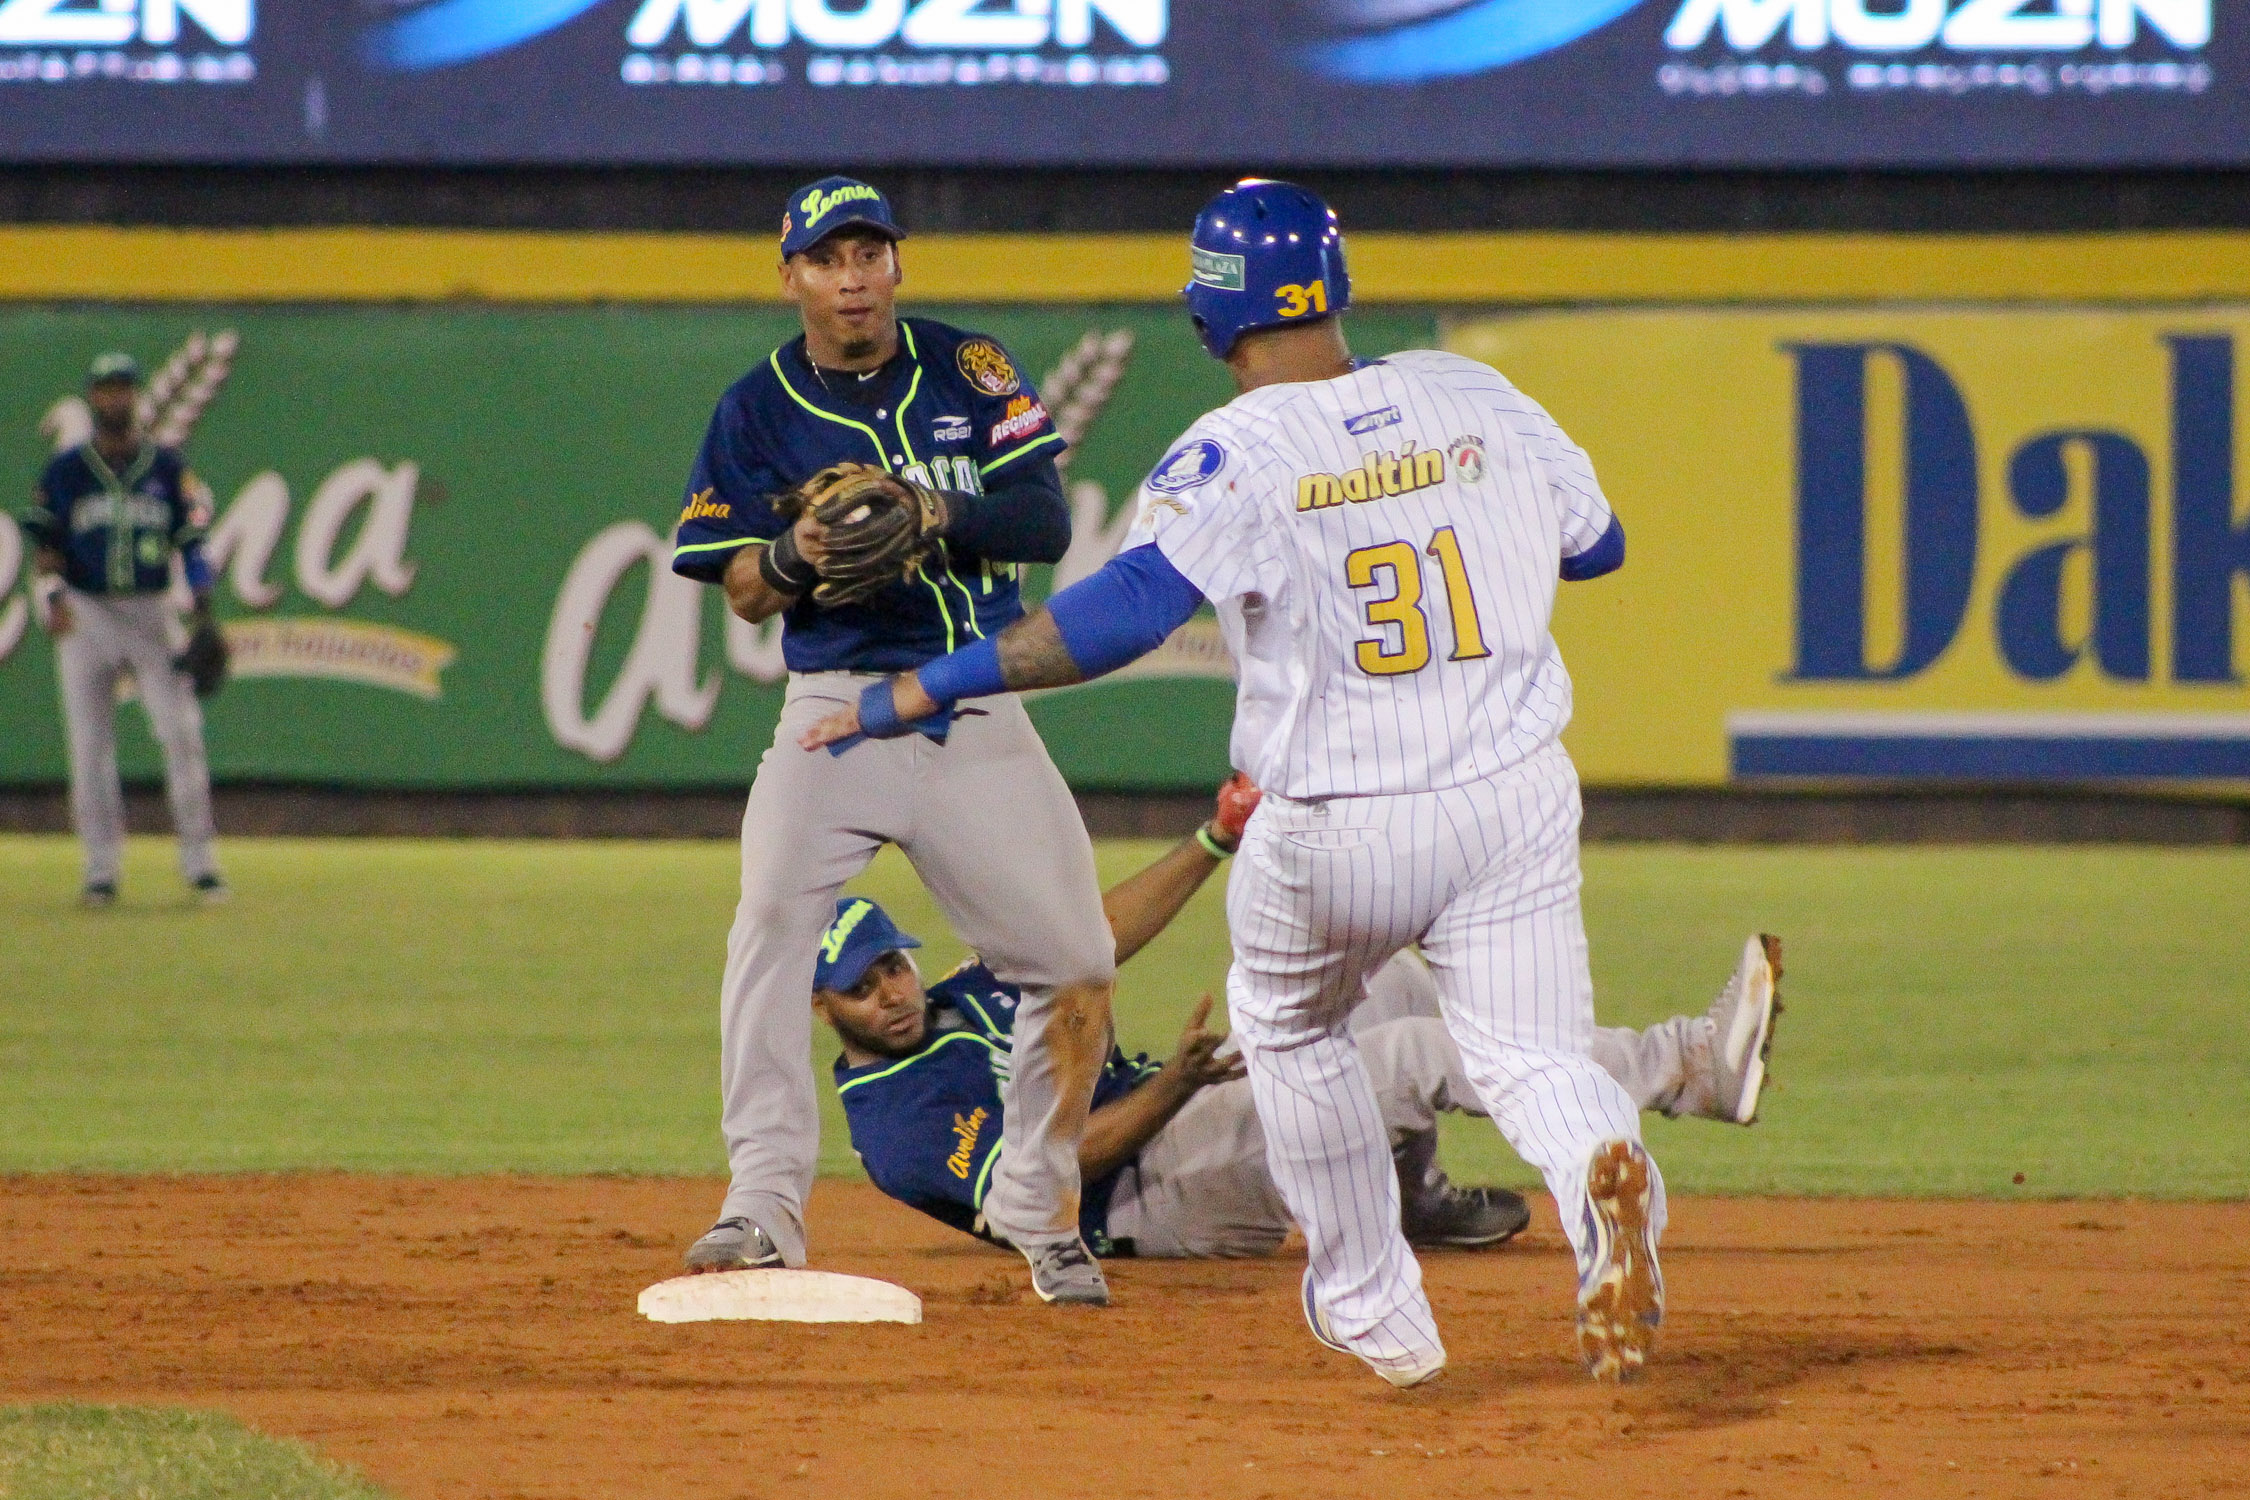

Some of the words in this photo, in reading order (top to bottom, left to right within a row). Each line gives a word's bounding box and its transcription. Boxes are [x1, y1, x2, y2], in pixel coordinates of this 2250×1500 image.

[800, 185, 880, 229] Leones
[1275, 279, 1328, 317] 31
[991, 402, 1048, 447] REGIONAL
[1296, 440, 1446, 512] maltín
[1345, 525, 1493, 676] 31
